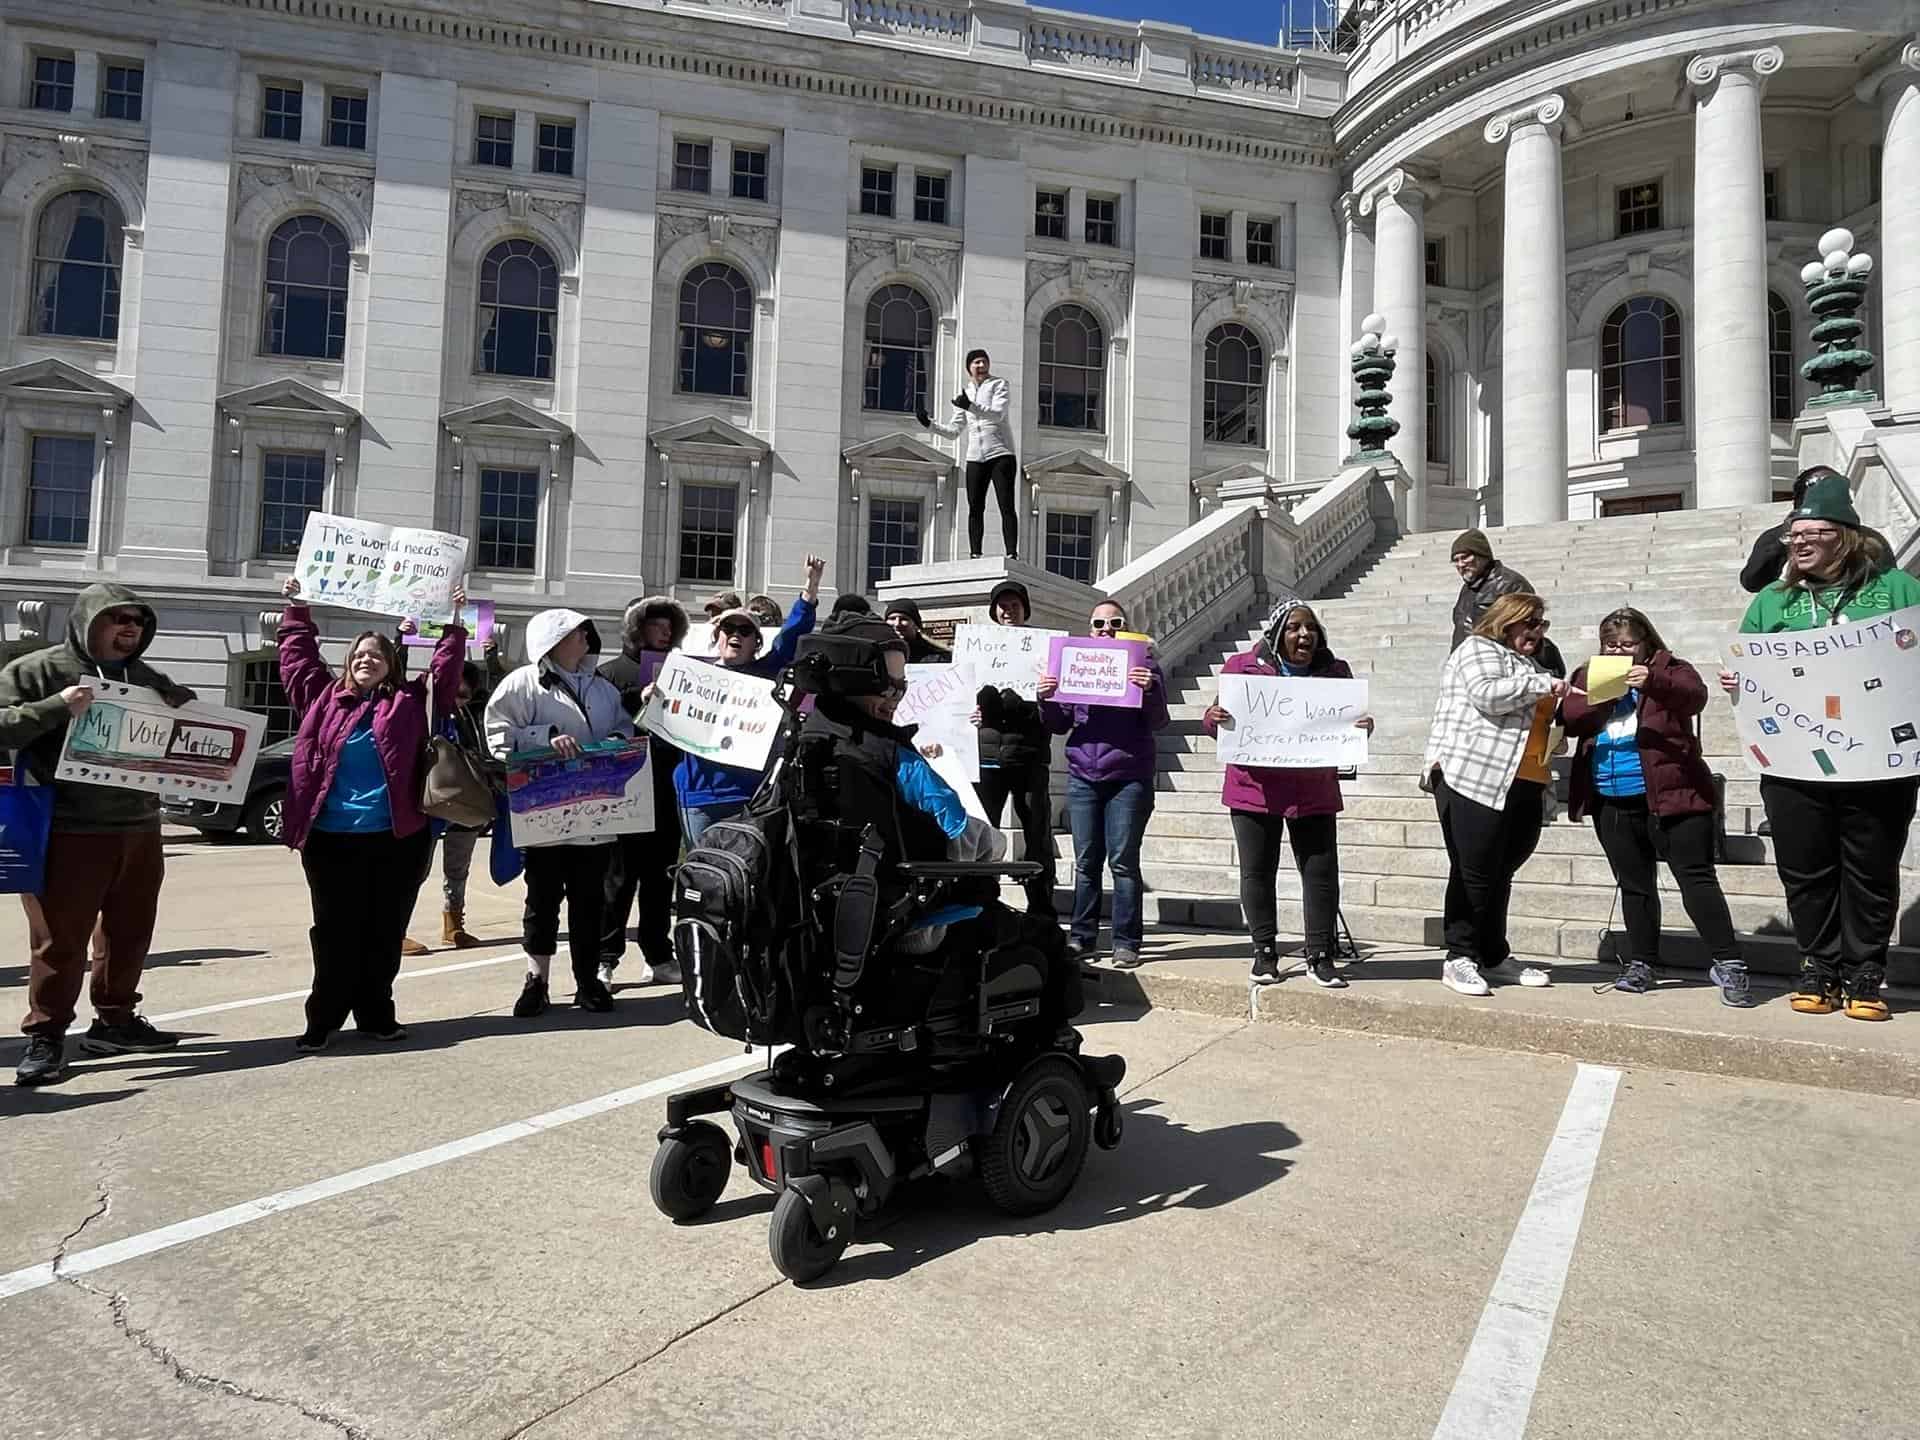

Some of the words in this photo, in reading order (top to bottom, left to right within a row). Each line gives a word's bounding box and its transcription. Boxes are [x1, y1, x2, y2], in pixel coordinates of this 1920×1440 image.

[320, 525, 354, 546] The
[361, 537, 400, 552] world
[404, 544, 440, 557] needs
[346, 552, 386, 570] kinds
[393, 560, 411, 574] of
[967, 637, 1008, 652] More
[1020, 635, 1033, 653] $
[1750, 616, 1896, 658] DISABILITY
[991, 656, 1009, 669] for
[1069, 663, 1097, 677] Rights
[1098, 666, 1119, 677] ARE
[1075, 651, 1114, 665] Disability
[668, 669, 692, 694] The
[696, 685, 728, 704] world
[1062, 676, 1095, 688] Human
[1245, 679, 1294, 718] We
[82, 709, 112, 749] My
[128, 717, 166, 746] Vote
[1744, 679, 1864, 752] DVOCACY
